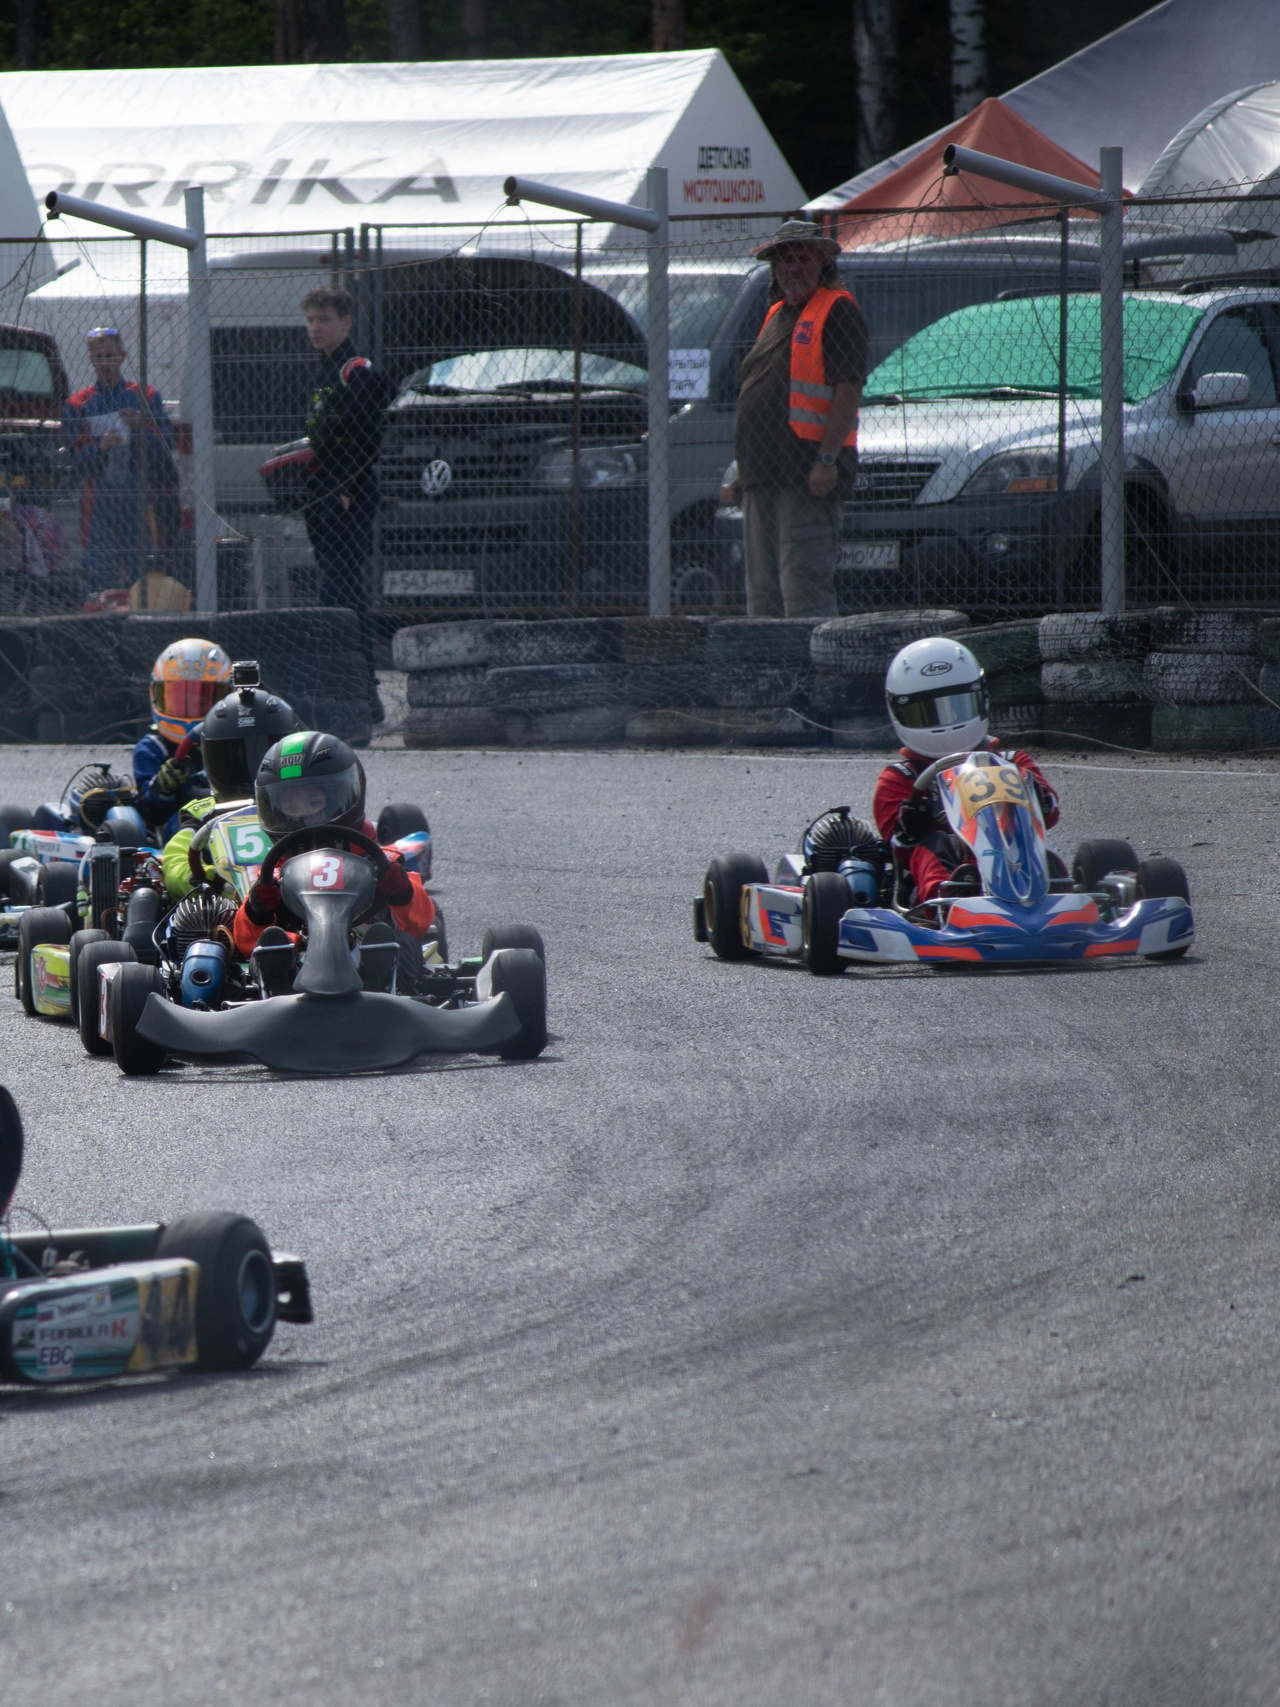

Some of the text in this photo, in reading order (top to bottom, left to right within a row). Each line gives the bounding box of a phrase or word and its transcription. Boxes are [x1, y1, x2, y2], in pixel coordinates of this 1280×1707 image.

[697, 146, 751, 172] ДЕТСКАЯ
[964, 767, 1026, 803] 39
[312, 857, 341, 888] 3
[110, 1318, 127, 1338] K
[39, 1346, 73, 1366] EBC
